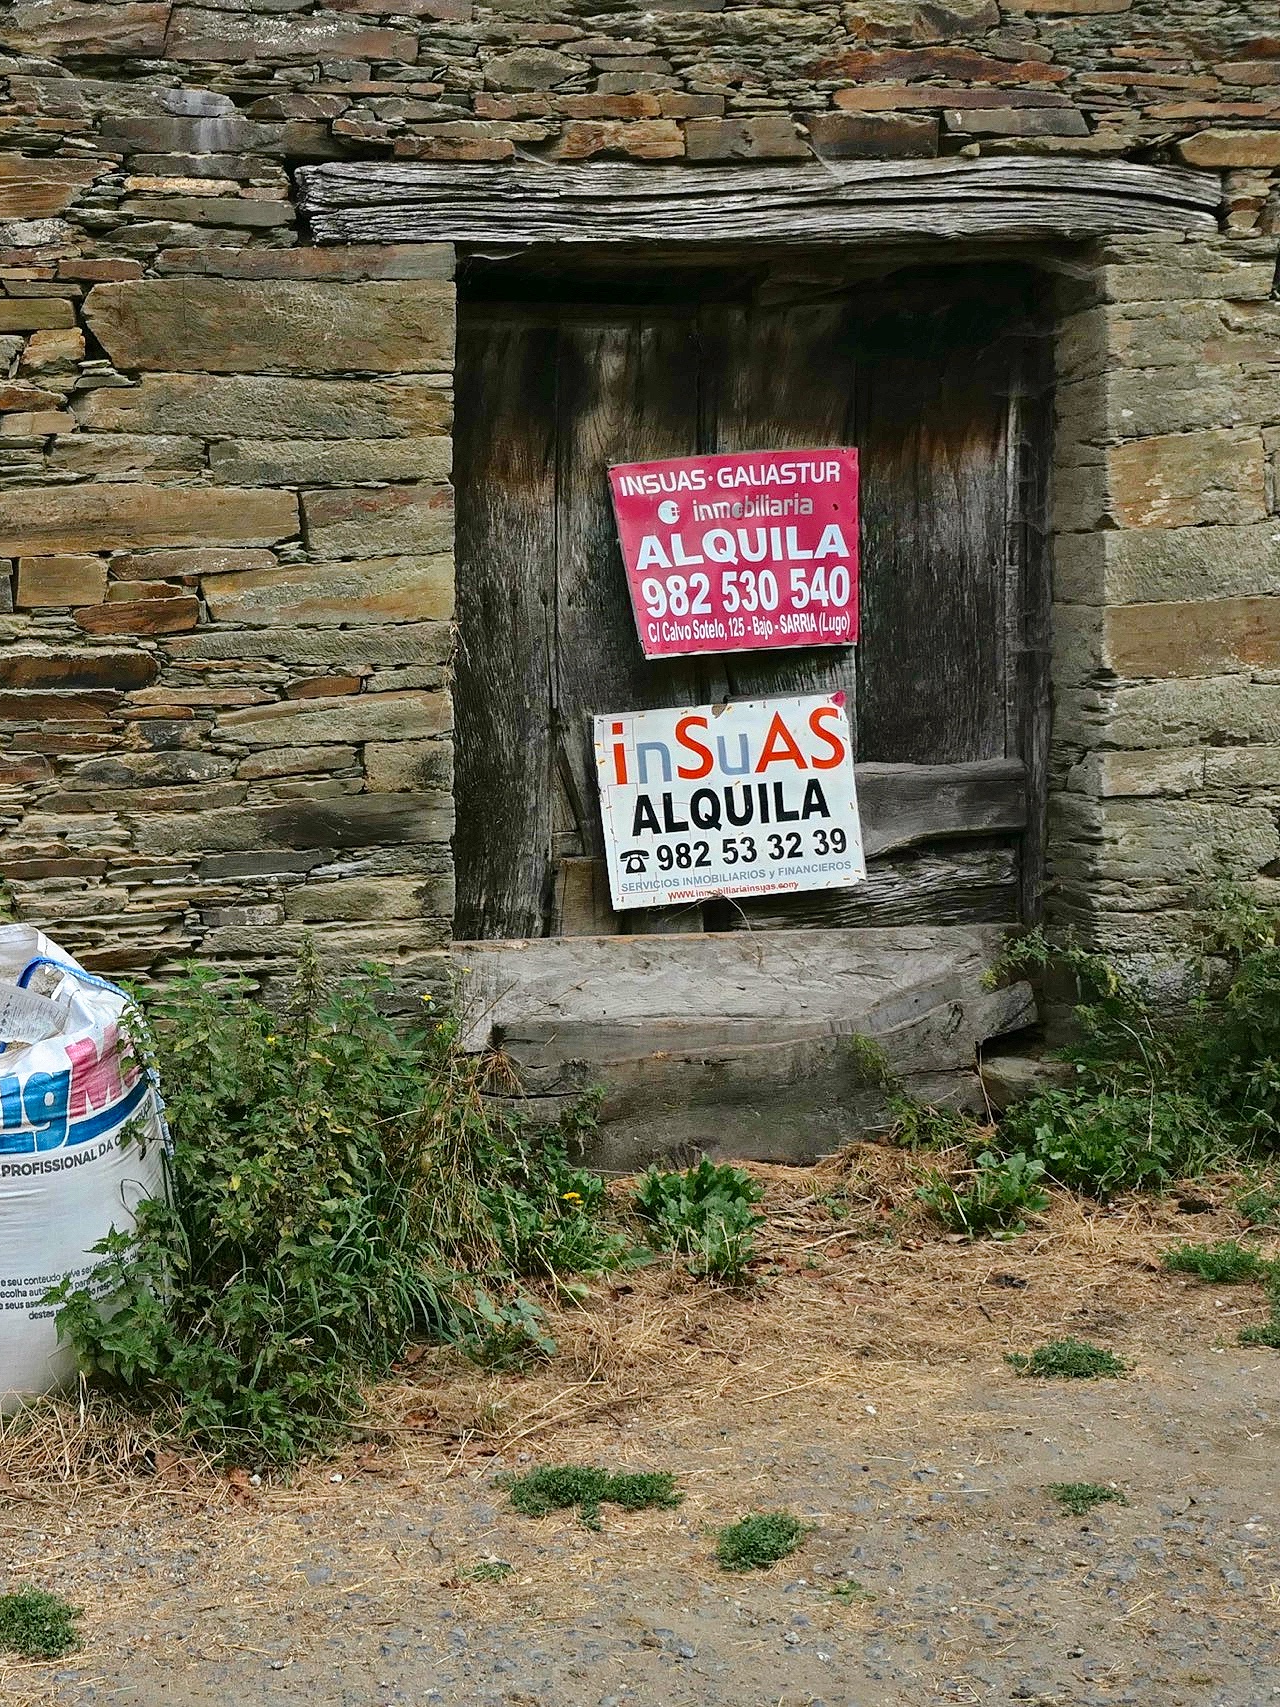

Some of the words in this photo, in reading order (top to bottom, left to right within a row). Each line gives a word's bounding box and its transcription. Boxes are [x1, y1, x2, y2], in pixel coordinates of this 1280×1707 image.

[619, 470, 706, 497] INSUAS
[717, 461, 840, 488] GALIASTUR
[693, 494, 814, 522] inmobiliaria
[636, 524, 850, 571] ALQUILA
[641, 572, 712, 618] 982
[721, 570, 779, 613] 530
[790, 566, 850, 608] 540
[662, 621, 692, 642] Calvo
[693, 619, 728, 640] Sotelo,
[728, 618, 745, 637] 125
[753, 616, 773, 639] Bajo
[779, 613, 817, 634] SARRIA
[819, 611, 850, 636] (Lugo)
[632, 778, 831, 837] ALQUILA
[657, 840, 711, 870] 982
[722, 836, 757, 865] 53
[768, 832, 803, 860] 32
[812, 827, 847, 856] 39
[621, 877, 680, 892] SERVICIOS
[682, 869, 766, 887] INMOBILIARIOS
[778, 860, 852, 876] FINANCIEROS
[1, 1149, 98, 1178] PROFISSIONAL
[98, 1139, 114, 1157] DA
